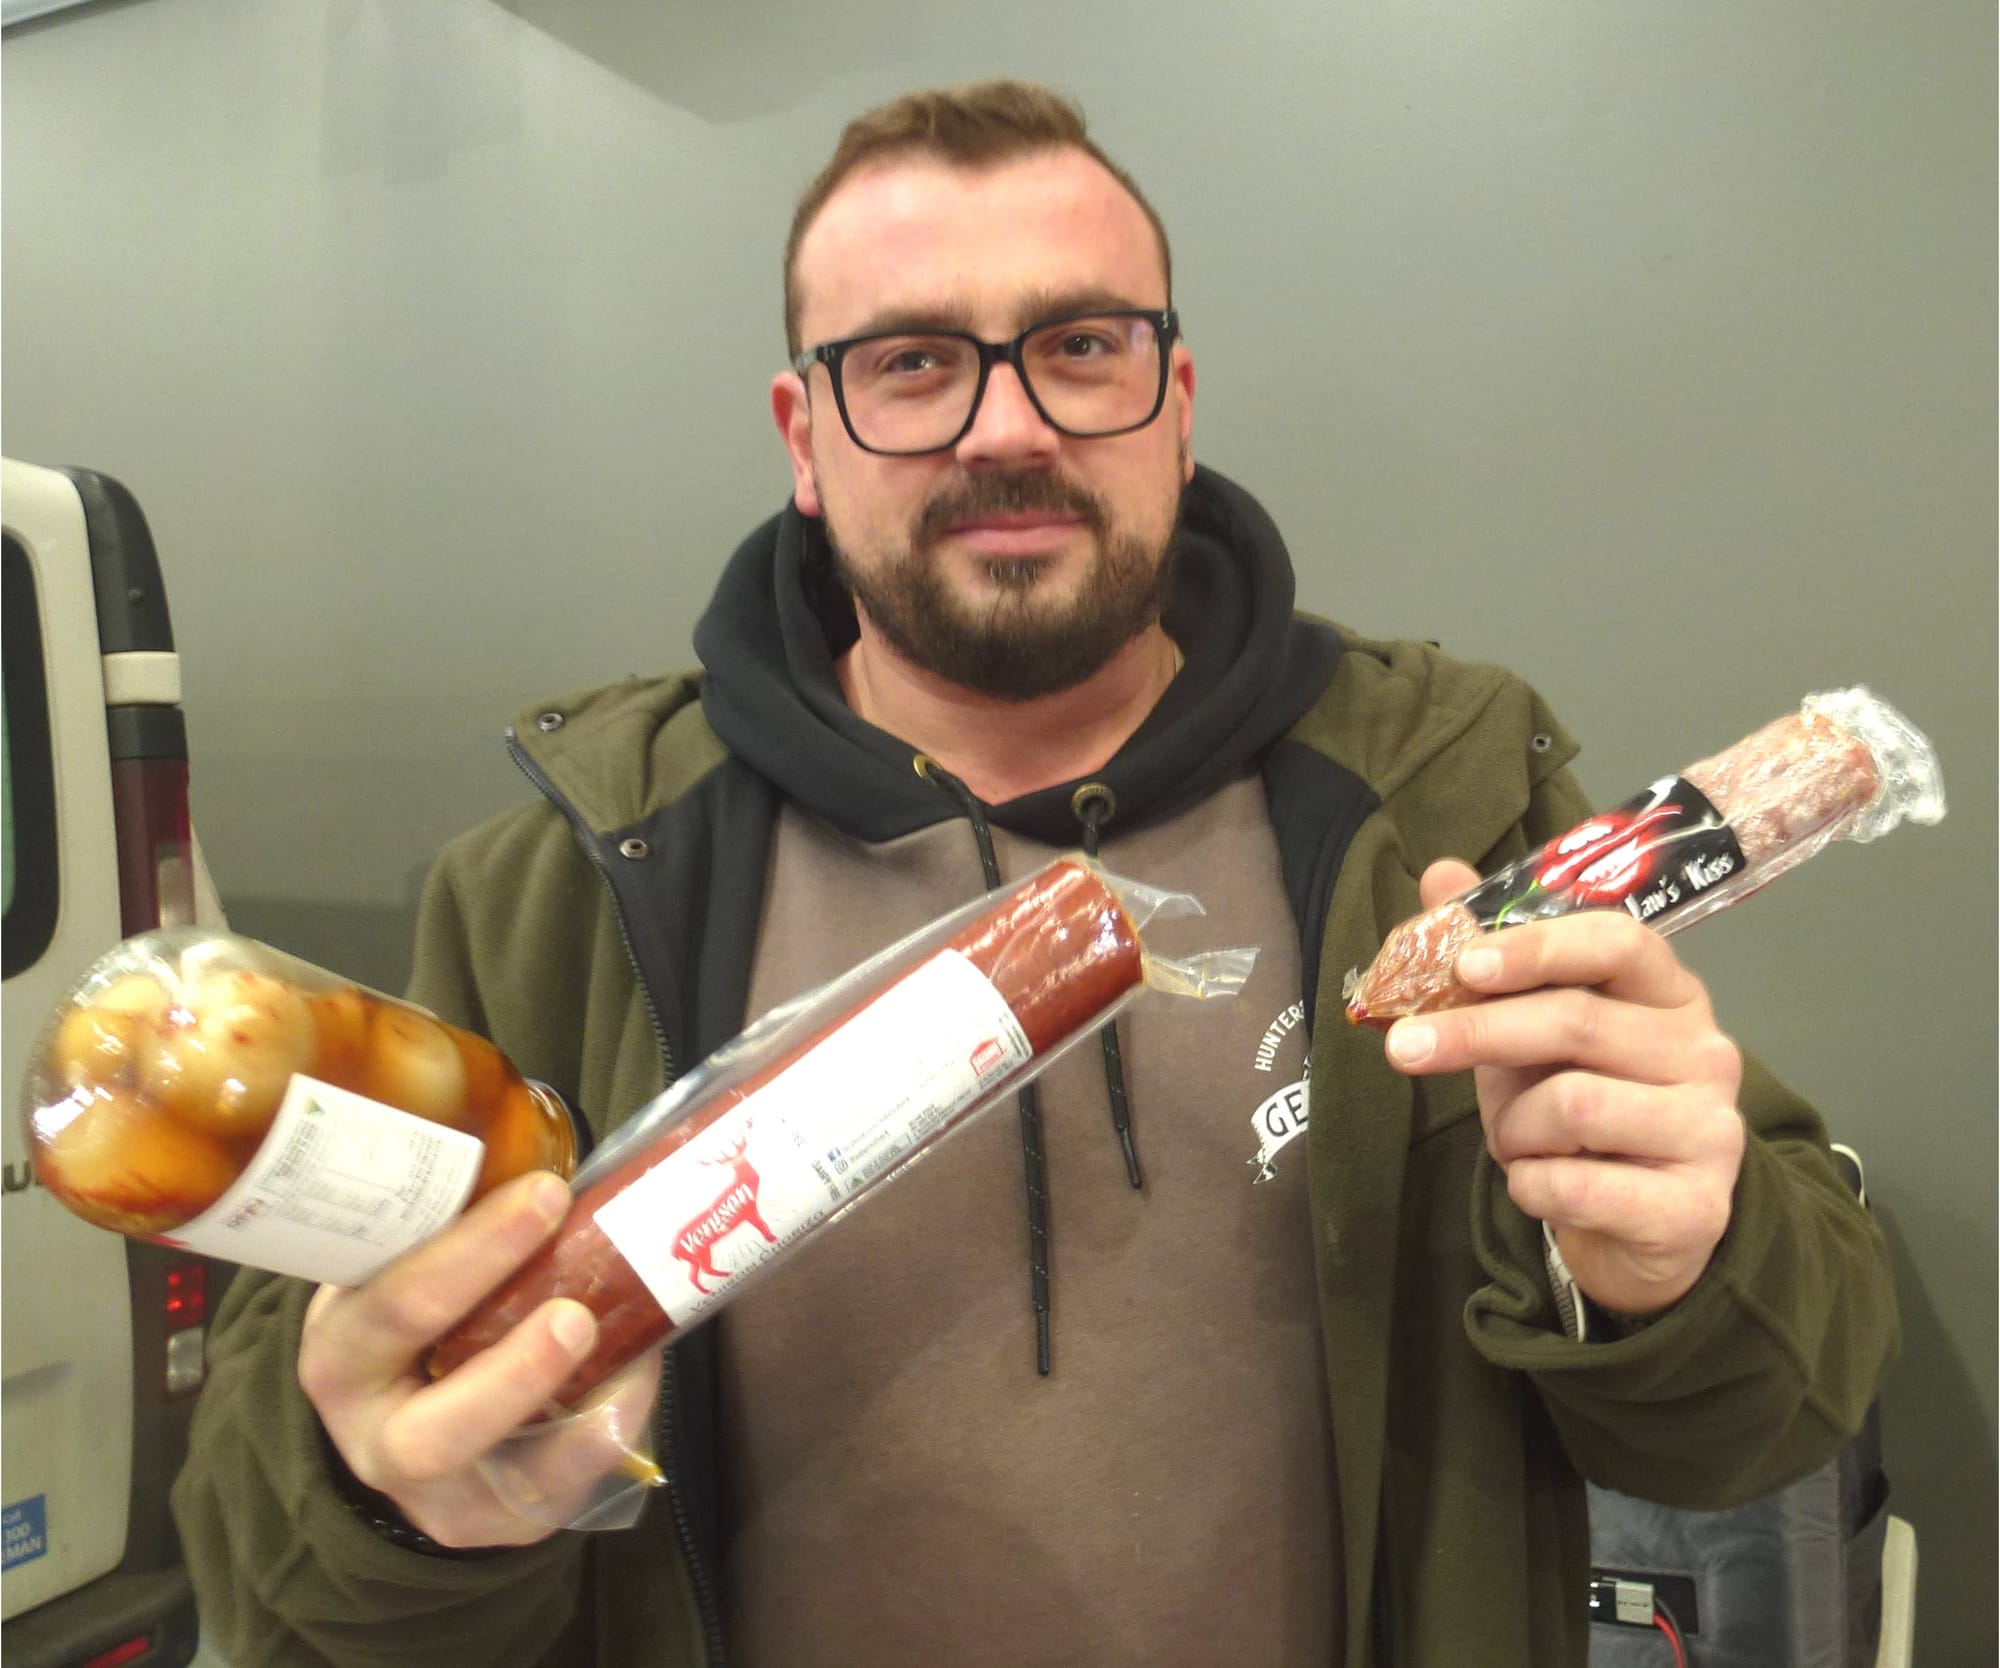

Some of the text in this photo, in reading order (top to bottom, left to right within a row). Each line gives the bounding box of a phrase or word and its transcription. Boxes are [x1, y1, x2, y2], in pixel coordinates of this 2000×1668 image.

[1624, 852, 1735, 921] Law's Kiss
[679, 1183, 754, 1255] Venison
